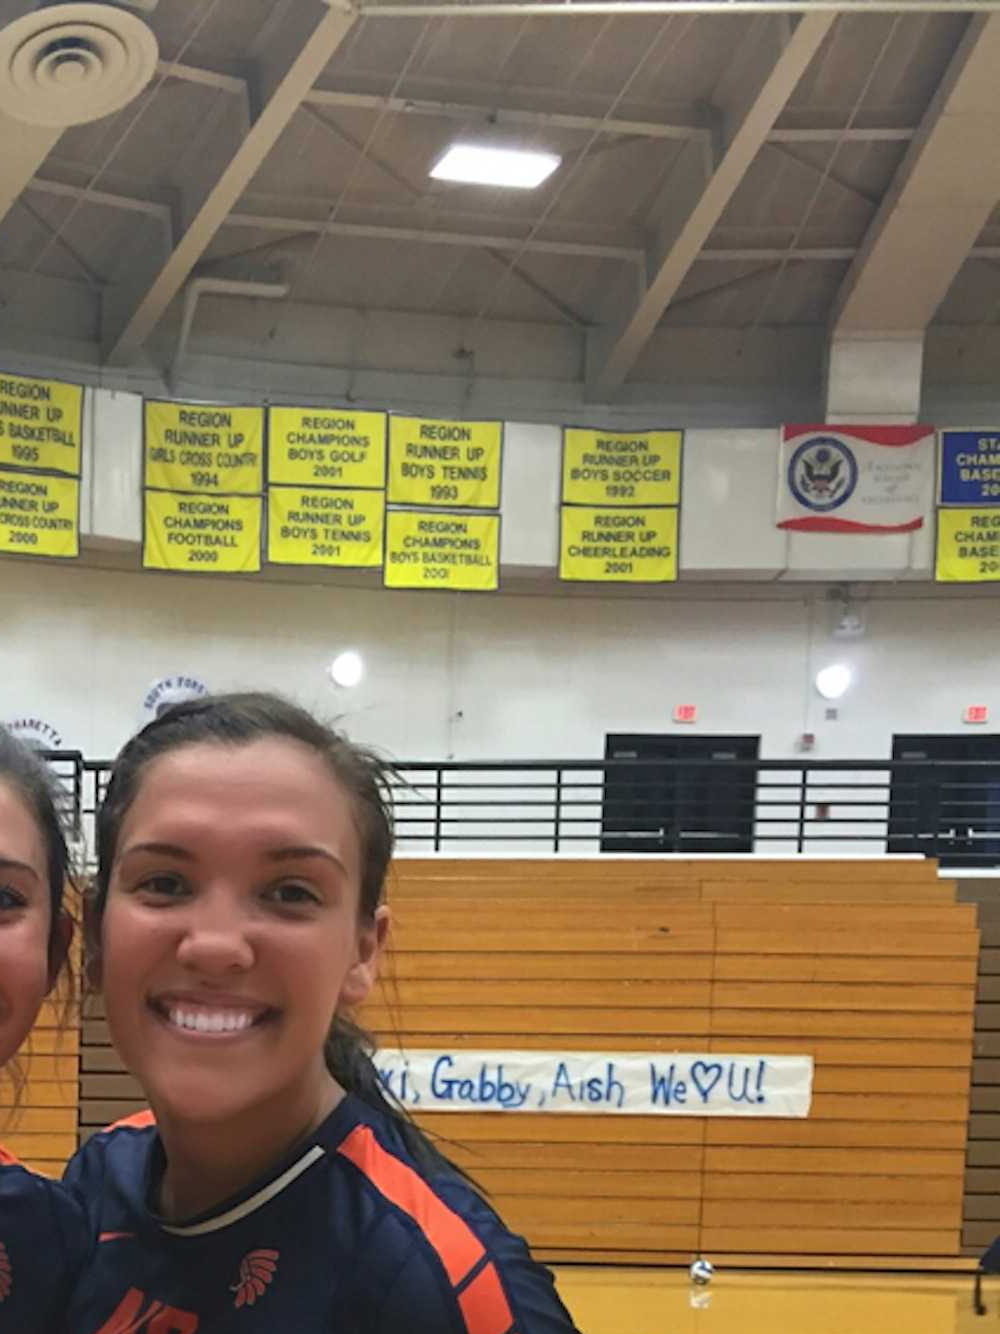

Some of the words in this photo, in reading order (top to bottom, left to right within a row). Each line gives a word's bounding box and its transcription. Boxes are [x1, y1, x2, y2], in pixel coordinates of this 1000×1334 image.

[0, 379, 51, 401] REGION
[46, 407, 63, 422] UP
[179, 410, 231, 428] REGION
[302, 416, 355, 430] REGION
[8, 422, 76, 448] BASKETBALL
[164, 429, 220, 446] RUNNER
[228, 433, 244, 448] UP
[287, 432, 370, 448] CHAMPIONS
[420, 424, 471, 441] REGION
[406, 443, 460, 460] RUNNER
[466, 447, 485, 461] UP
[596, 439, 649, 453] REGION
[180, 451, 212, 466] CROSS
[288, 448, 325, 461] BOYS
[330, 450, 367, 463] GOLF
[582, 453, 638, 466] RUNNER
[643, 454, 661, 466] UP
[313, 465, 343, 478] 2001
[401, 462, 434, 479] BOYS
[442, 466, 488, 482] TENNIS
[571, 467, 609, 481] BOYS
[613, 470, 671, 482] SOCCER
[42, 500, 59, 513] UP
[178, 502, 229, 515] REGION
[301, 495, 354, 509] REGION
[163, 516, 243, 531] CHAMPIONS
[287, 511, 342, 525] RUNNER
[348, 515, 365, 526] UP
[594, 516, 646, 527] REGION
[281, 526, 318, 540] BOYS
[324, 529, 371, 542] TENNIS
[418, 520, 467, 534] REGION
[168, 532, 238, 547] FOOTBALL
[403, 535, 481, 550] CHAMPIONS
[582, 531, 634, 542] RUNNER
[640, 531, 657, 542] UP
[390, 551, 419, 564] BOYS
[422, 552, 491, 567] BASKETBALL
[568, 546, 671, 558] CHEERLEADING
[650, 1062, 687, 1106] We
